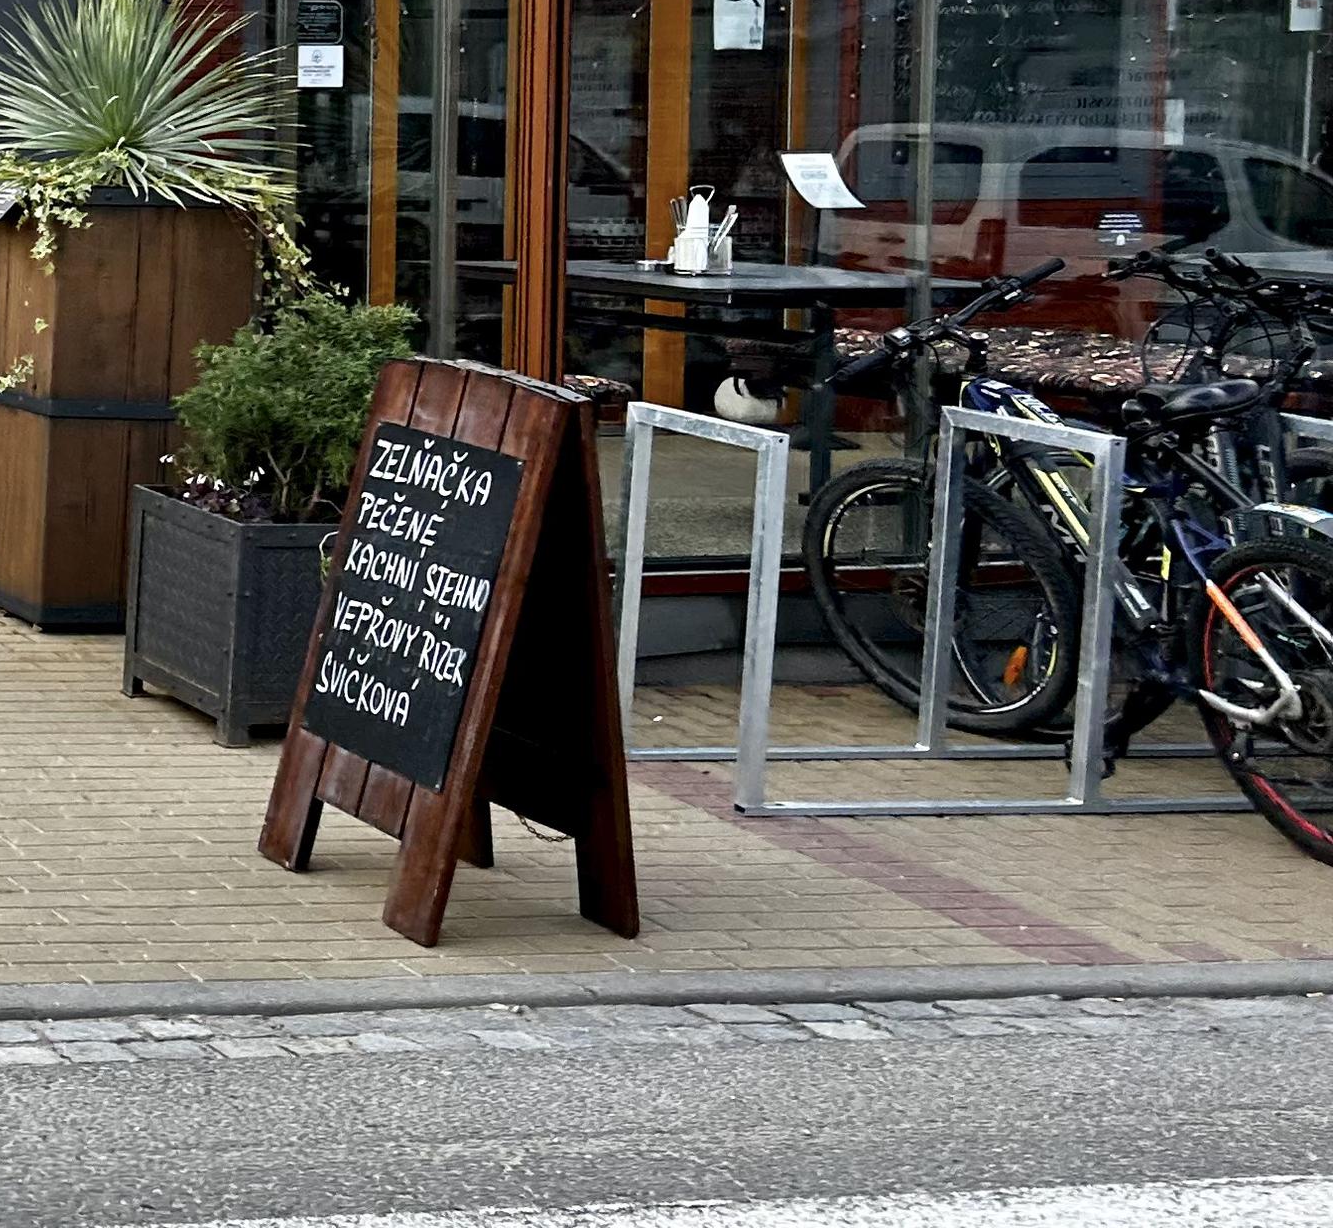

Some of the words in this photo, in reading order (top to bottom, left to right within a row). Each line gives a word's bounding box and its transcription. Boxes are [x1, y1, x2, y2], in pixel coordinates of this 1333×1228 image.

[368, 438, 493, 507] ZELŇAČKA
[357, 491, 450, 548] PEČENÉ
[344, 538, 426, 593] KACHNÍ
[423, 562, 491, 613] STEHNO
[333, 590, 425, 659] VEPŘOVÝ
[419, 612, 468, 688] ŘÍZEK
[316, 647, 421, 727] SVÍČKOVÁ
